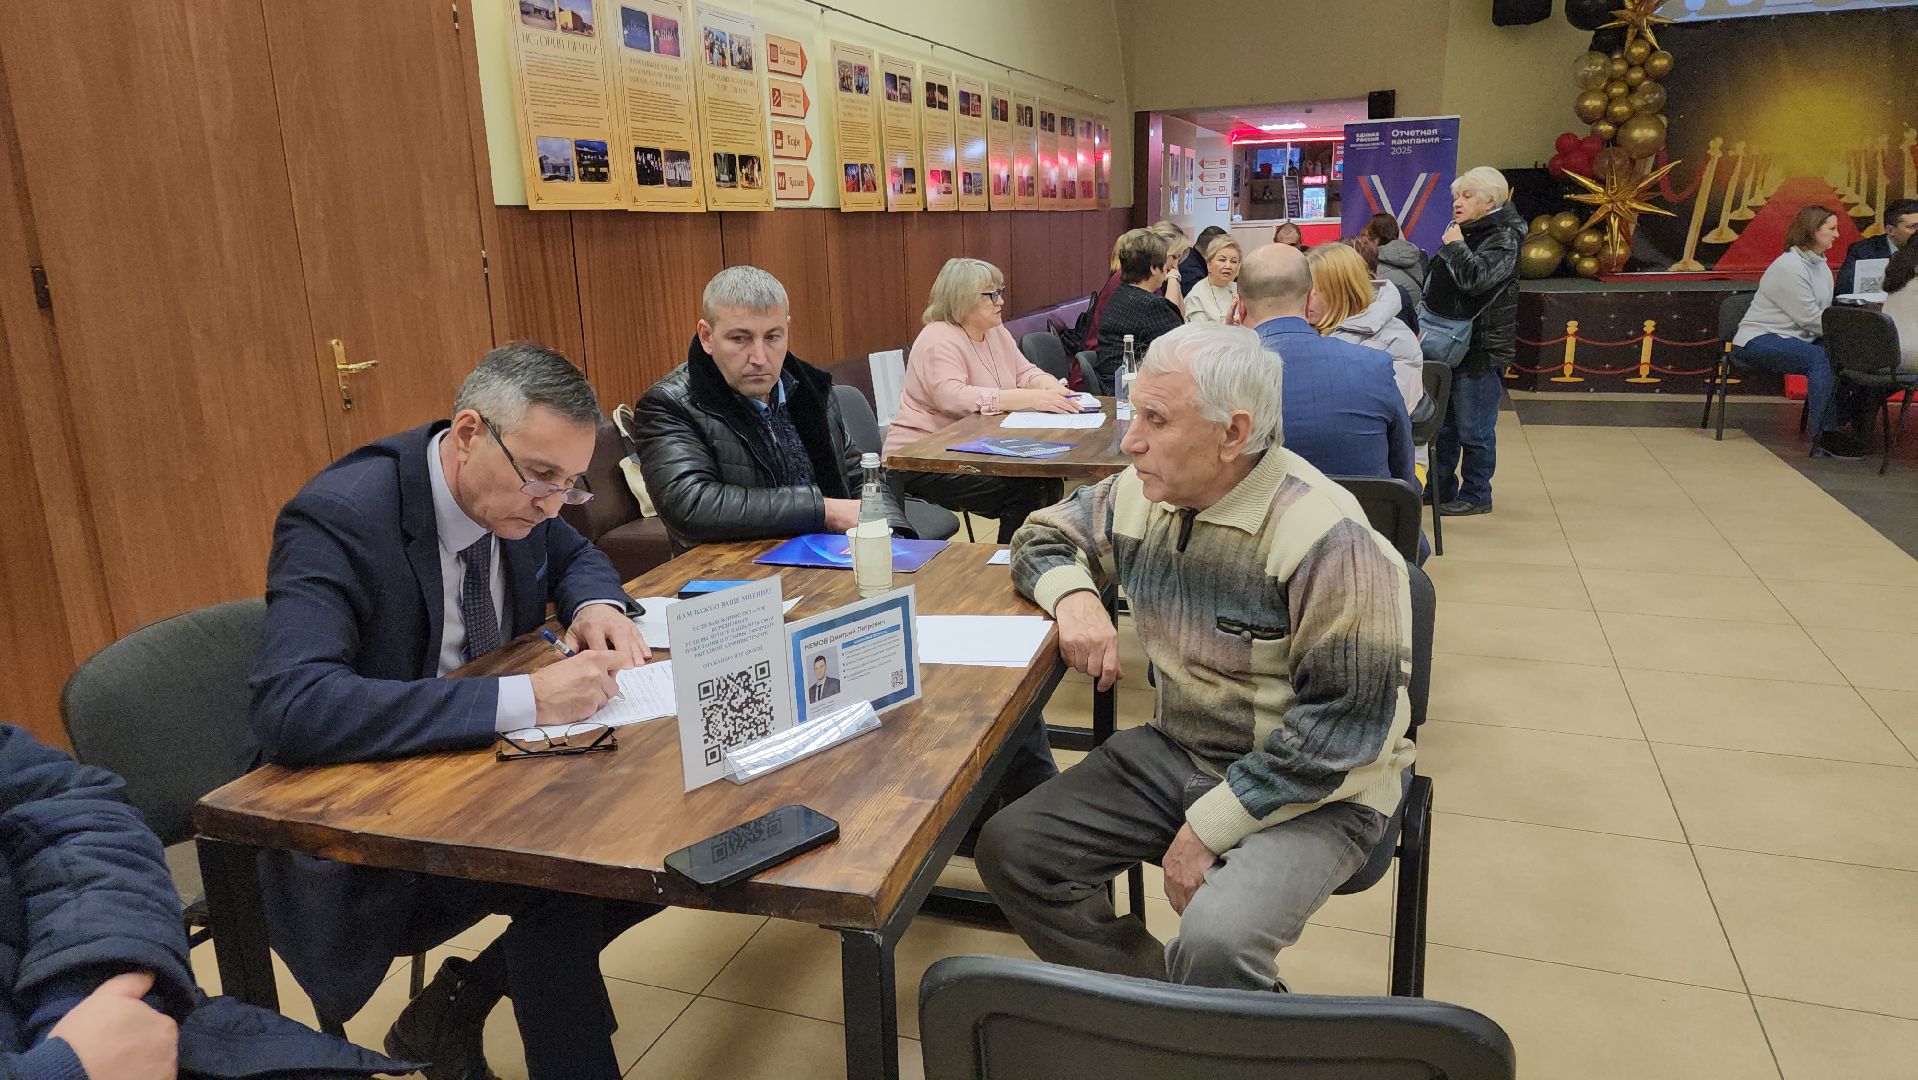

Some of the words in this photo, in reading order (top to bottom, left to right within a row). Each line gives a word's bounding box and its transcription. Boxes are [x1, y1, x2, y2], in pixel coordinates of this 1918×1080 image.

[1392, 129, 1438, 137] Отчетная
[1391, 137, 1440, 145] кампания
[1391, 146, 1412, 155] 2025
[804, 637, 828, 651] НЕМОВ
[829, 628, 855, 643] Дмитрий
[857, 618, 885, 634] Петрович
